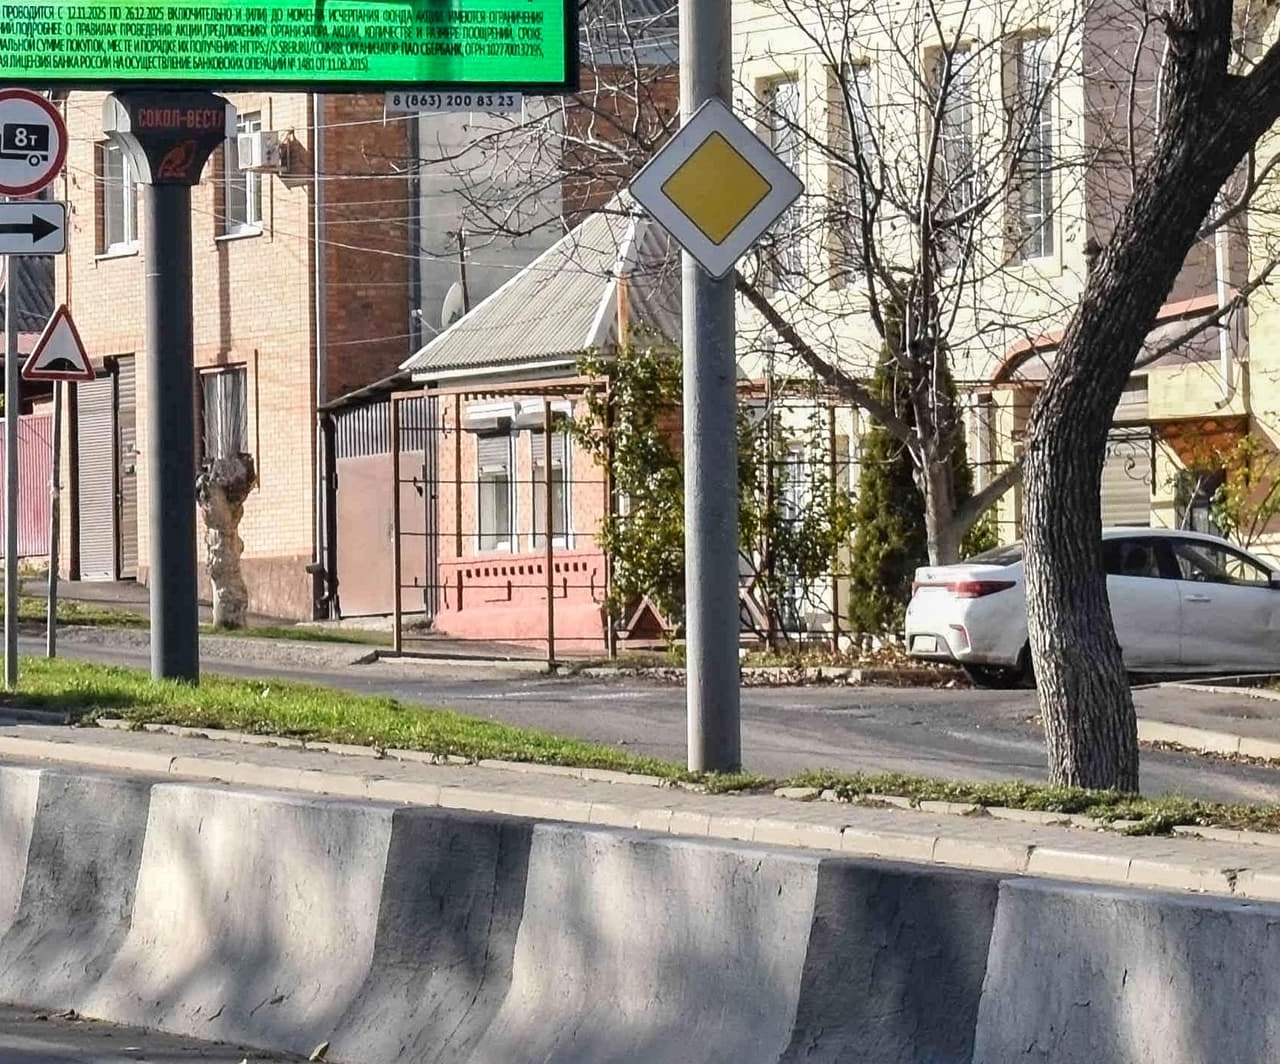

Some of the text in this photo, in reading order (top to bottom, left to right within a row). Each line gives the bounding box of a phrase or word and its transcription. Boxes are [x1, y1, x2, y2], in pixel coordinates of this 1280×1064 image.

[392, 93, 514, 109] 8 (863) 200 83 23
